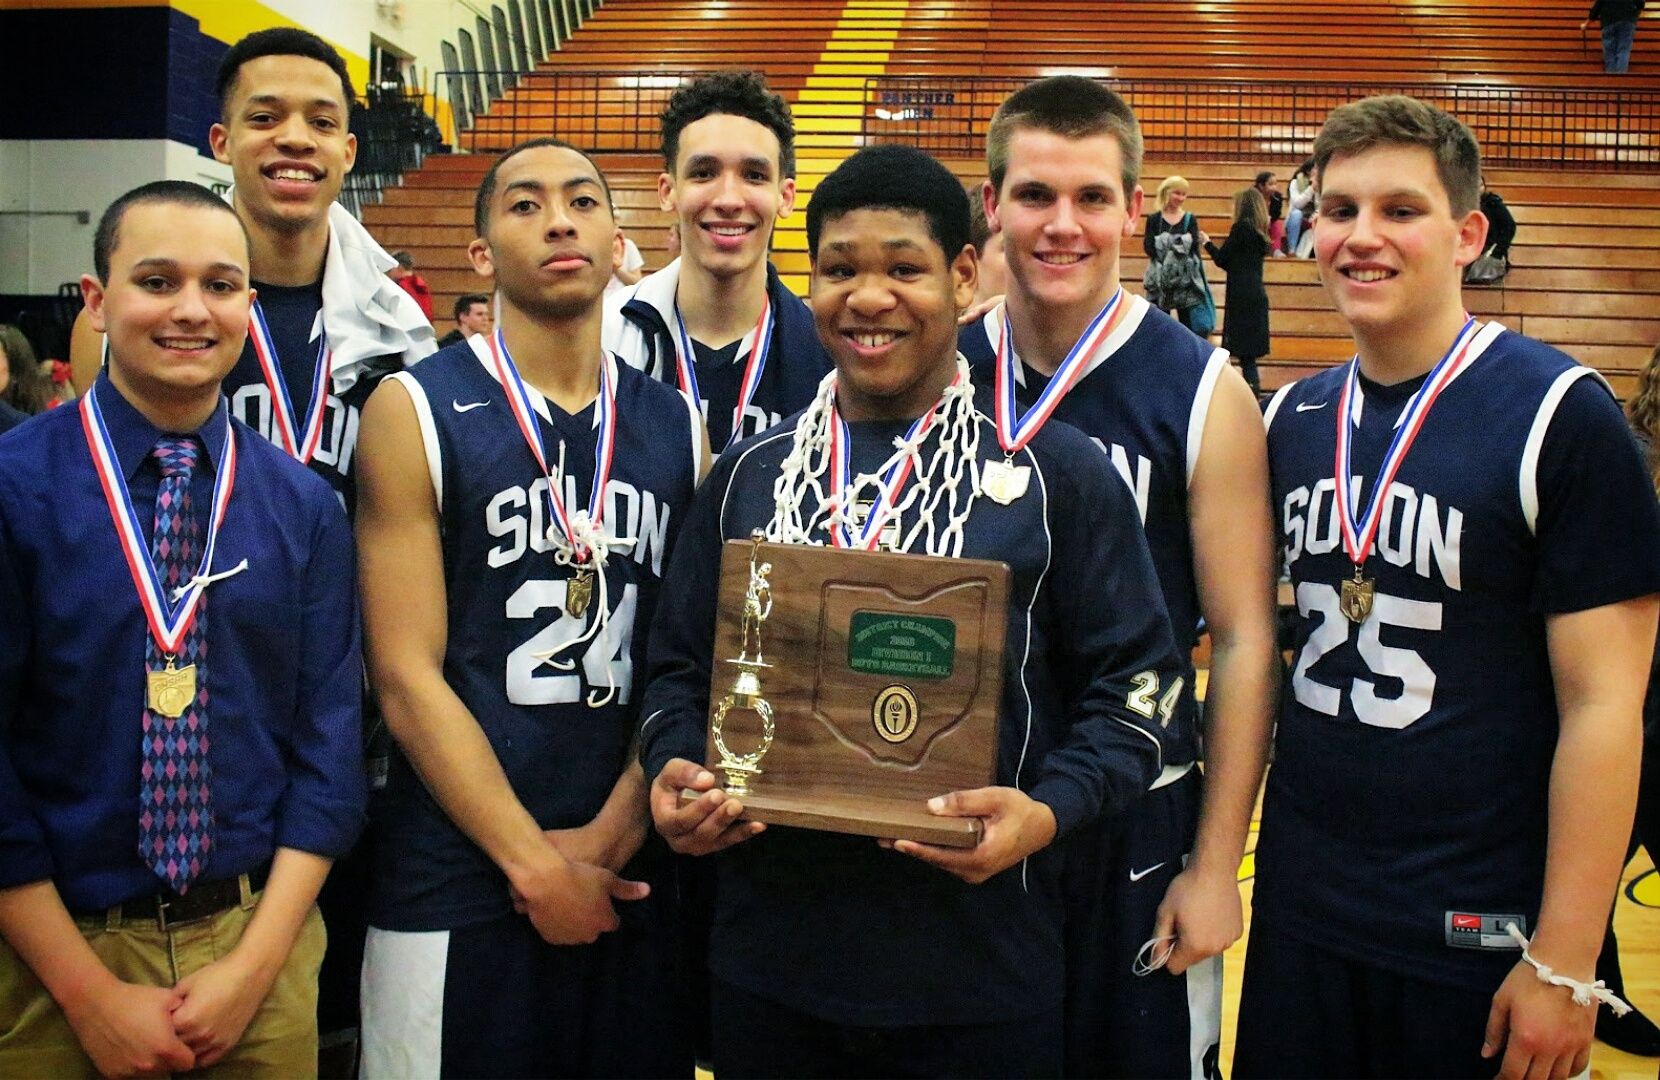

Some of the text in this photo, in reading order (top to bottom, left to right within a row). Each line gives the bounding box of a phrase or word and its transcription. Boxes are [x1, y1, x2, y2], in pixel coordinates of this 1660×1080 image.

[882, 91, 954, 104] PANTHER
[506, 579, 638, 705] 24
[1293, 581, 1443, 729] 25
[1125, 669, 1185, 729] 24
